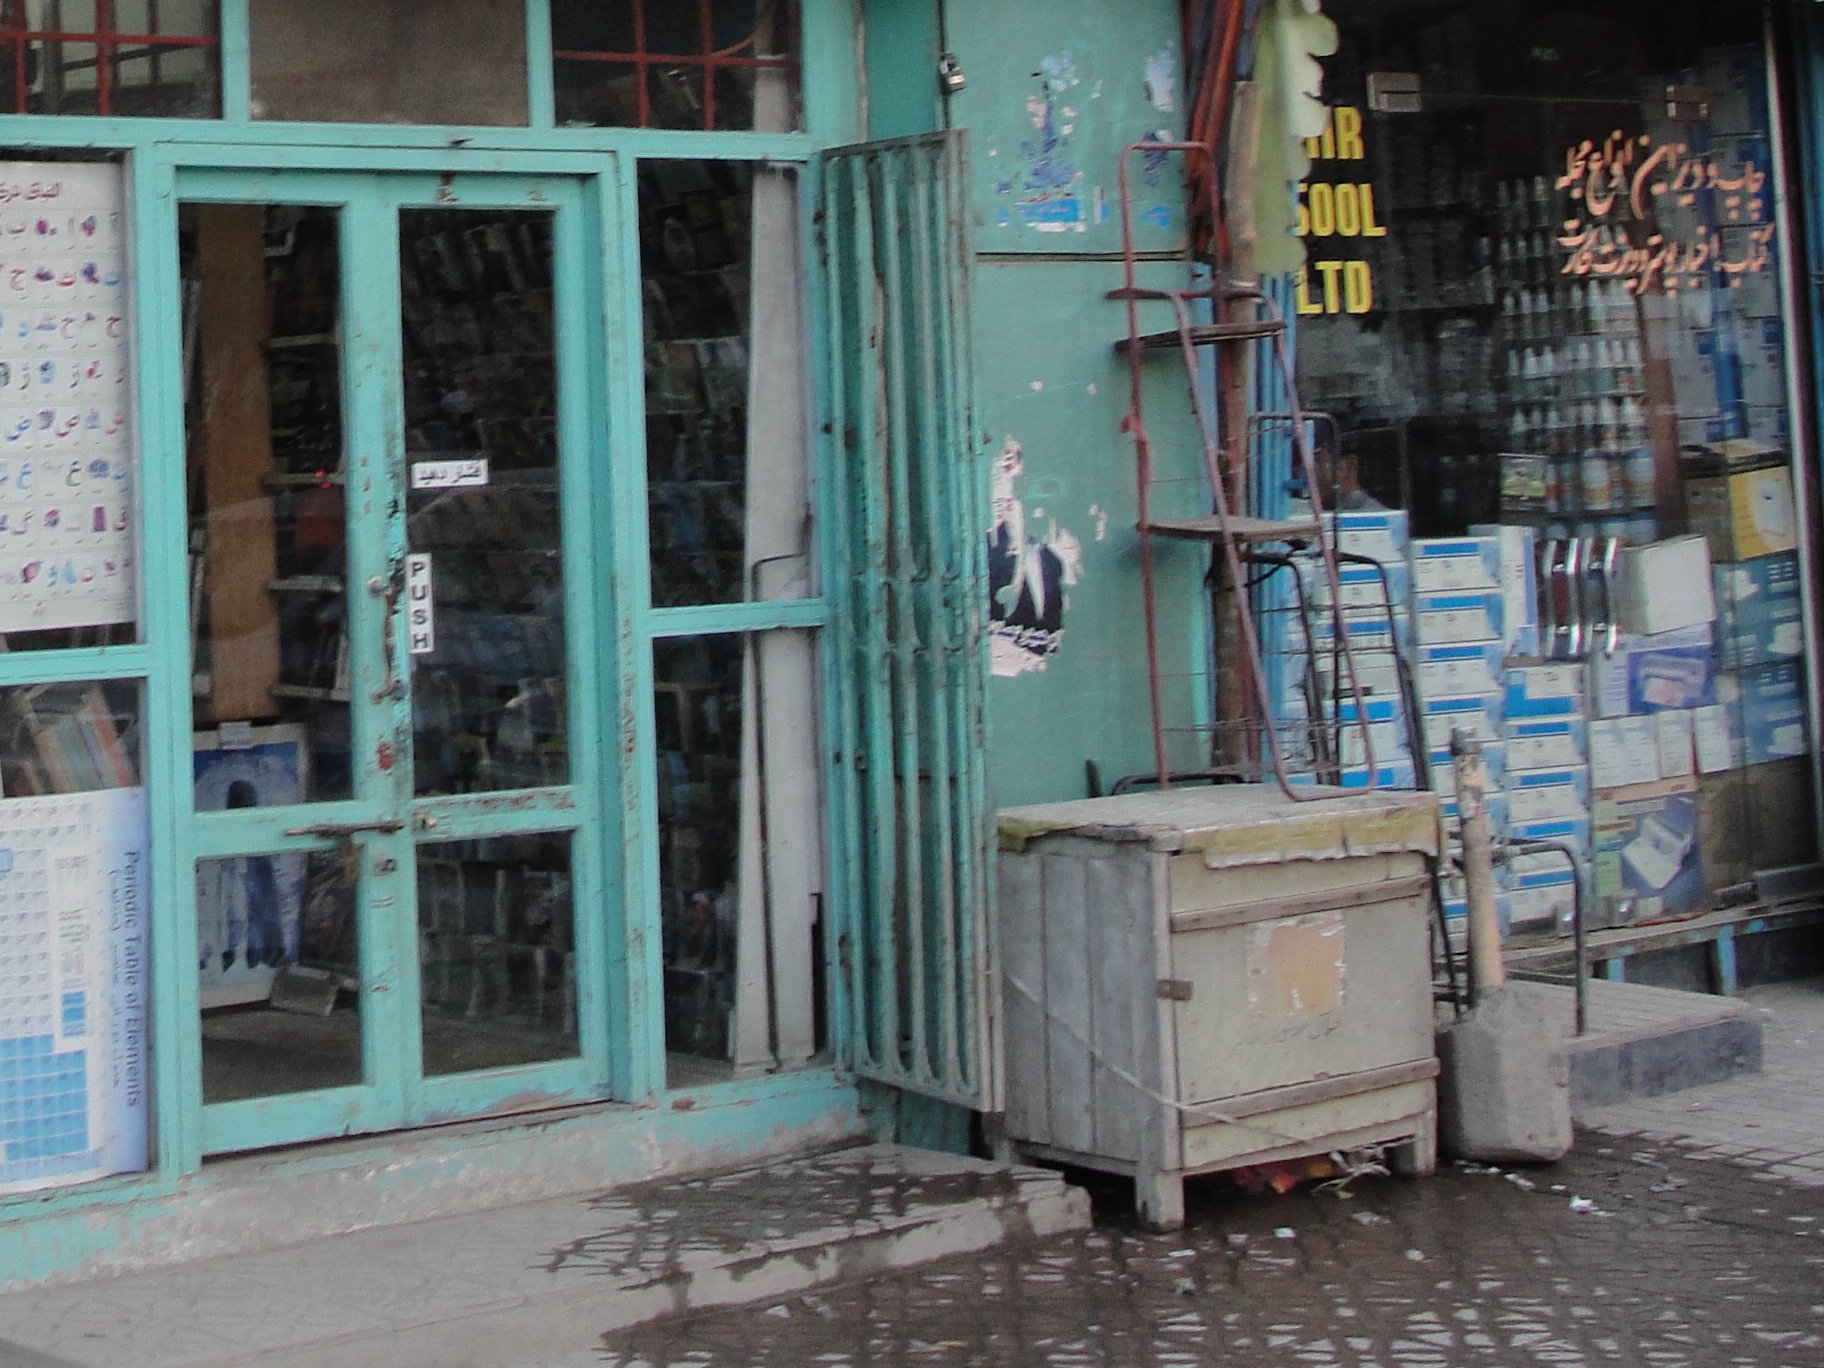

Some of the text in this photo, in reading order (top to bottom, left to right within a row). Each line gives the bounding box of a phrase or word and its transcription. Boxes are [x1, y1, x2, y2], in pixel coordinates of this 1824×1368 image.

[1294, 183, 1387, 237] SOOL
[1295, 261, 1372, 314] LTD
[410, 561, 429, 649] PUSH
[123, 850, 142, 929] Periodic
[124, 935, 142, 986] Table
[125, 1017, 143, 1107] Elements
